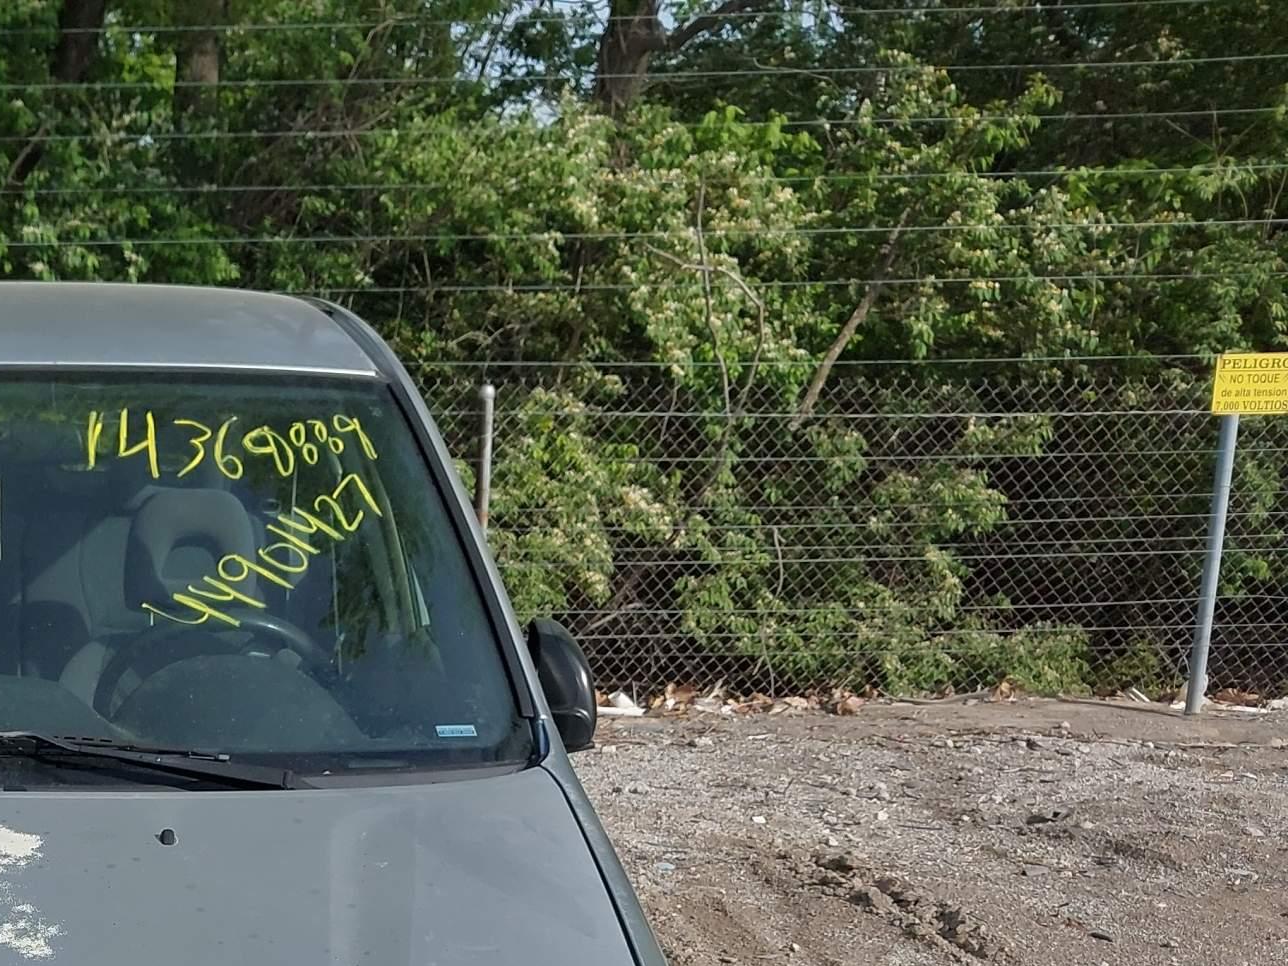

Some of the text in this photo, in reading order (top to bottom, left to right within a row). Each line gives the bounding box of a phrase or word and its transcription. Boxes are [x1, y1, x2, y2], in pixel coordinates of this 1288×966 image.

[1229, 373, 1281, 384] NO TOQUE
[1221, 387, 1288, 397] de alta tension
[1242, 400, 1288, 410] VOLTIOS
[142, 474, 382, 627] 44901427
